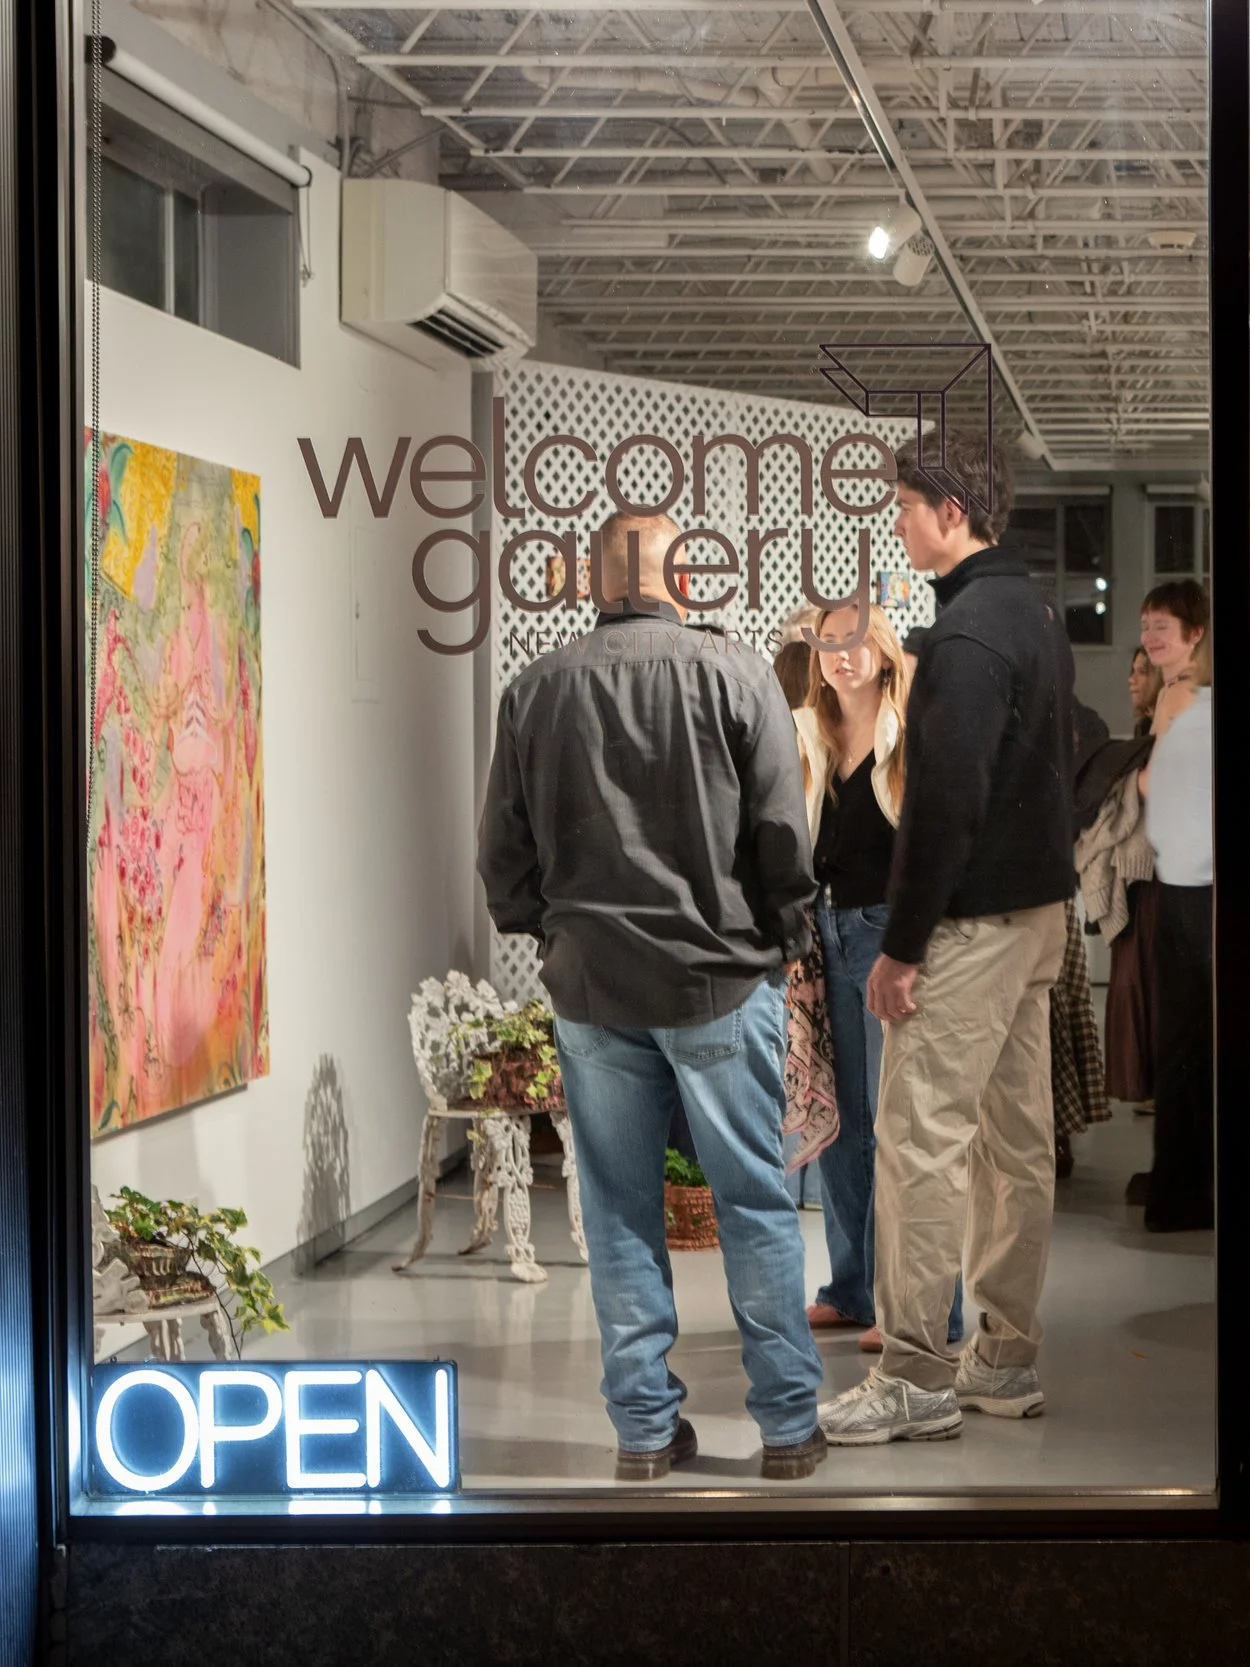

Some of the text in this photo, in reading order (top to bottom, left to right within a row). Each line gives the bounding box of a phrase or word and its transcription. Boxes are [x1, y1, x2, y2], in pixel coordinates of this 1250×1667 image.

[297, 396, 899, 519] welcome
[411, 527, 871, 656] gallery
[508, 629, 785, 656] NEW CITY ARTS
[95, 1368, 451, 1492] OPEN
